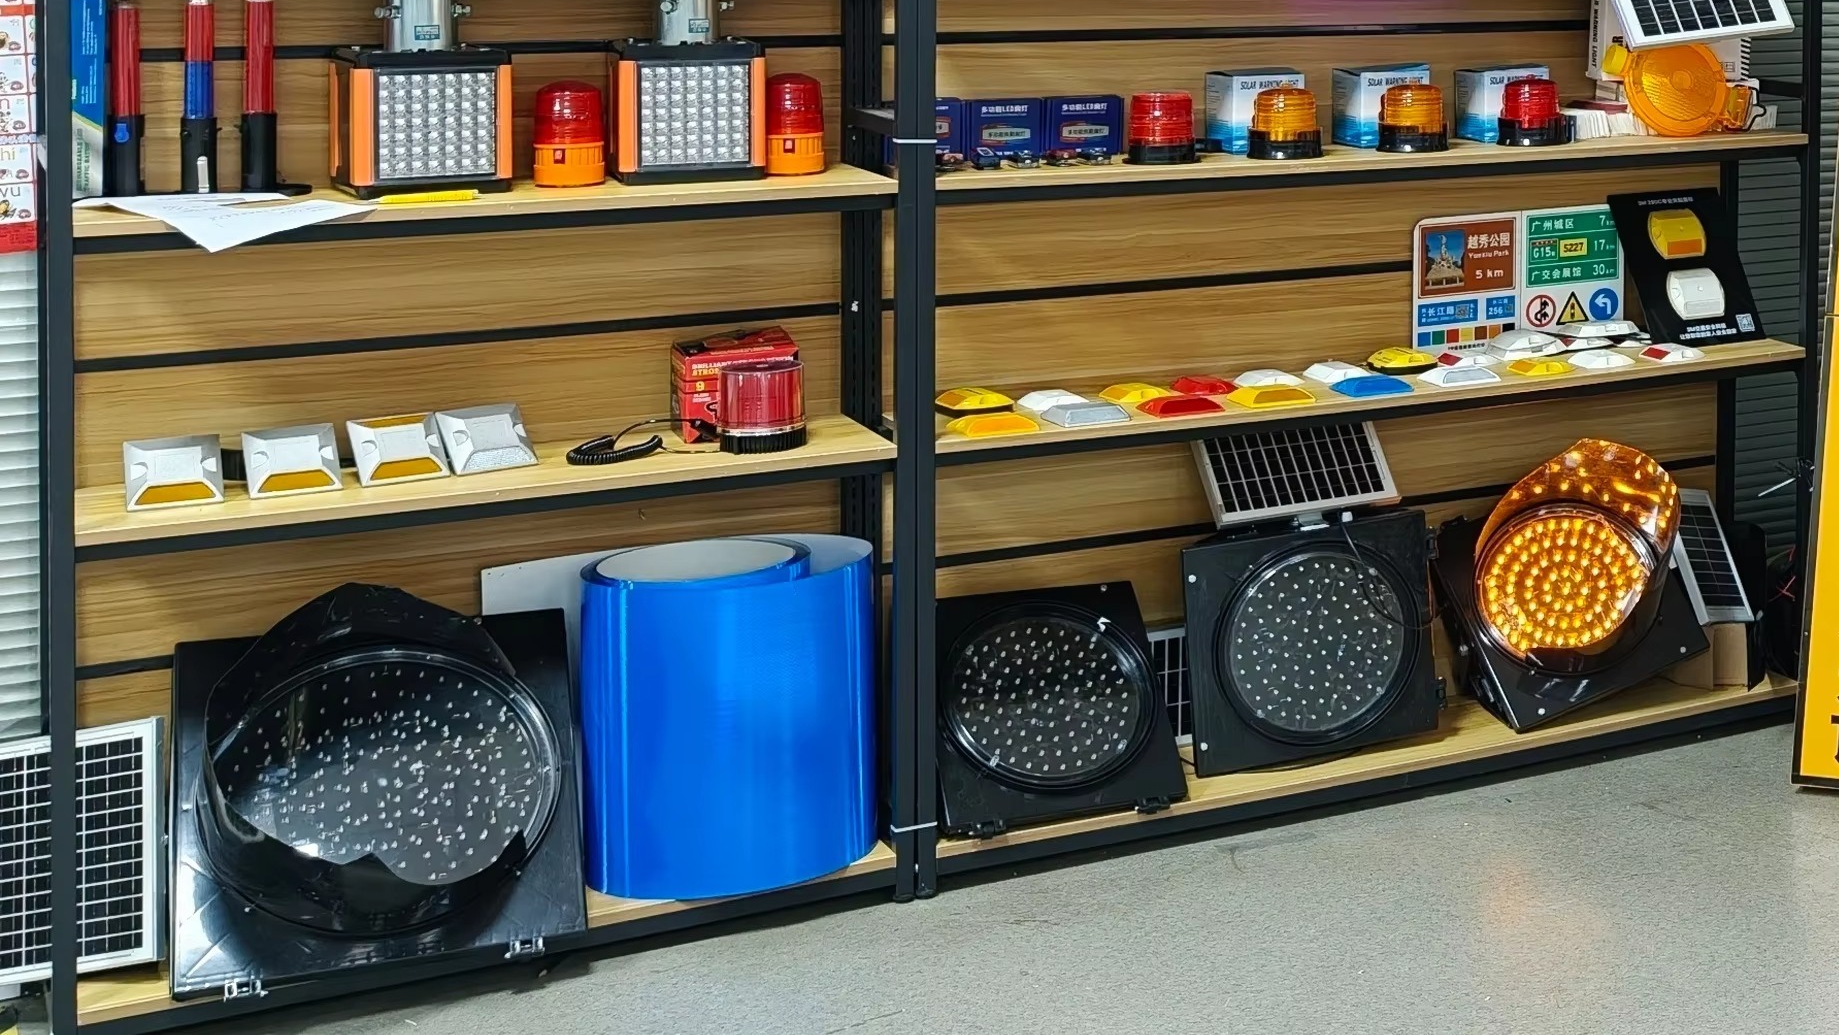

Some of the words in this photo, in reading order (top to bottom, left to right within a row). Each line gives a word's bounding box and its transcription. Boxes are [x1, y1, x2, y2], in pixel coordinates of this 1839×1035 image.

[1240, 80, 1257, 91] SOLAR
[1367, 77, 1383, 87] SOLAR
[1489, 76, 1505, 86] SOLAR
[1531, 218, 1575, 232] 广州城区
[1467, 232, 1511, 250] 越秀公园
[1563, 242, 1584, 253] S227
[1475, 269, 1483, 279] 5
[1486, 268, 1504, 278] km
